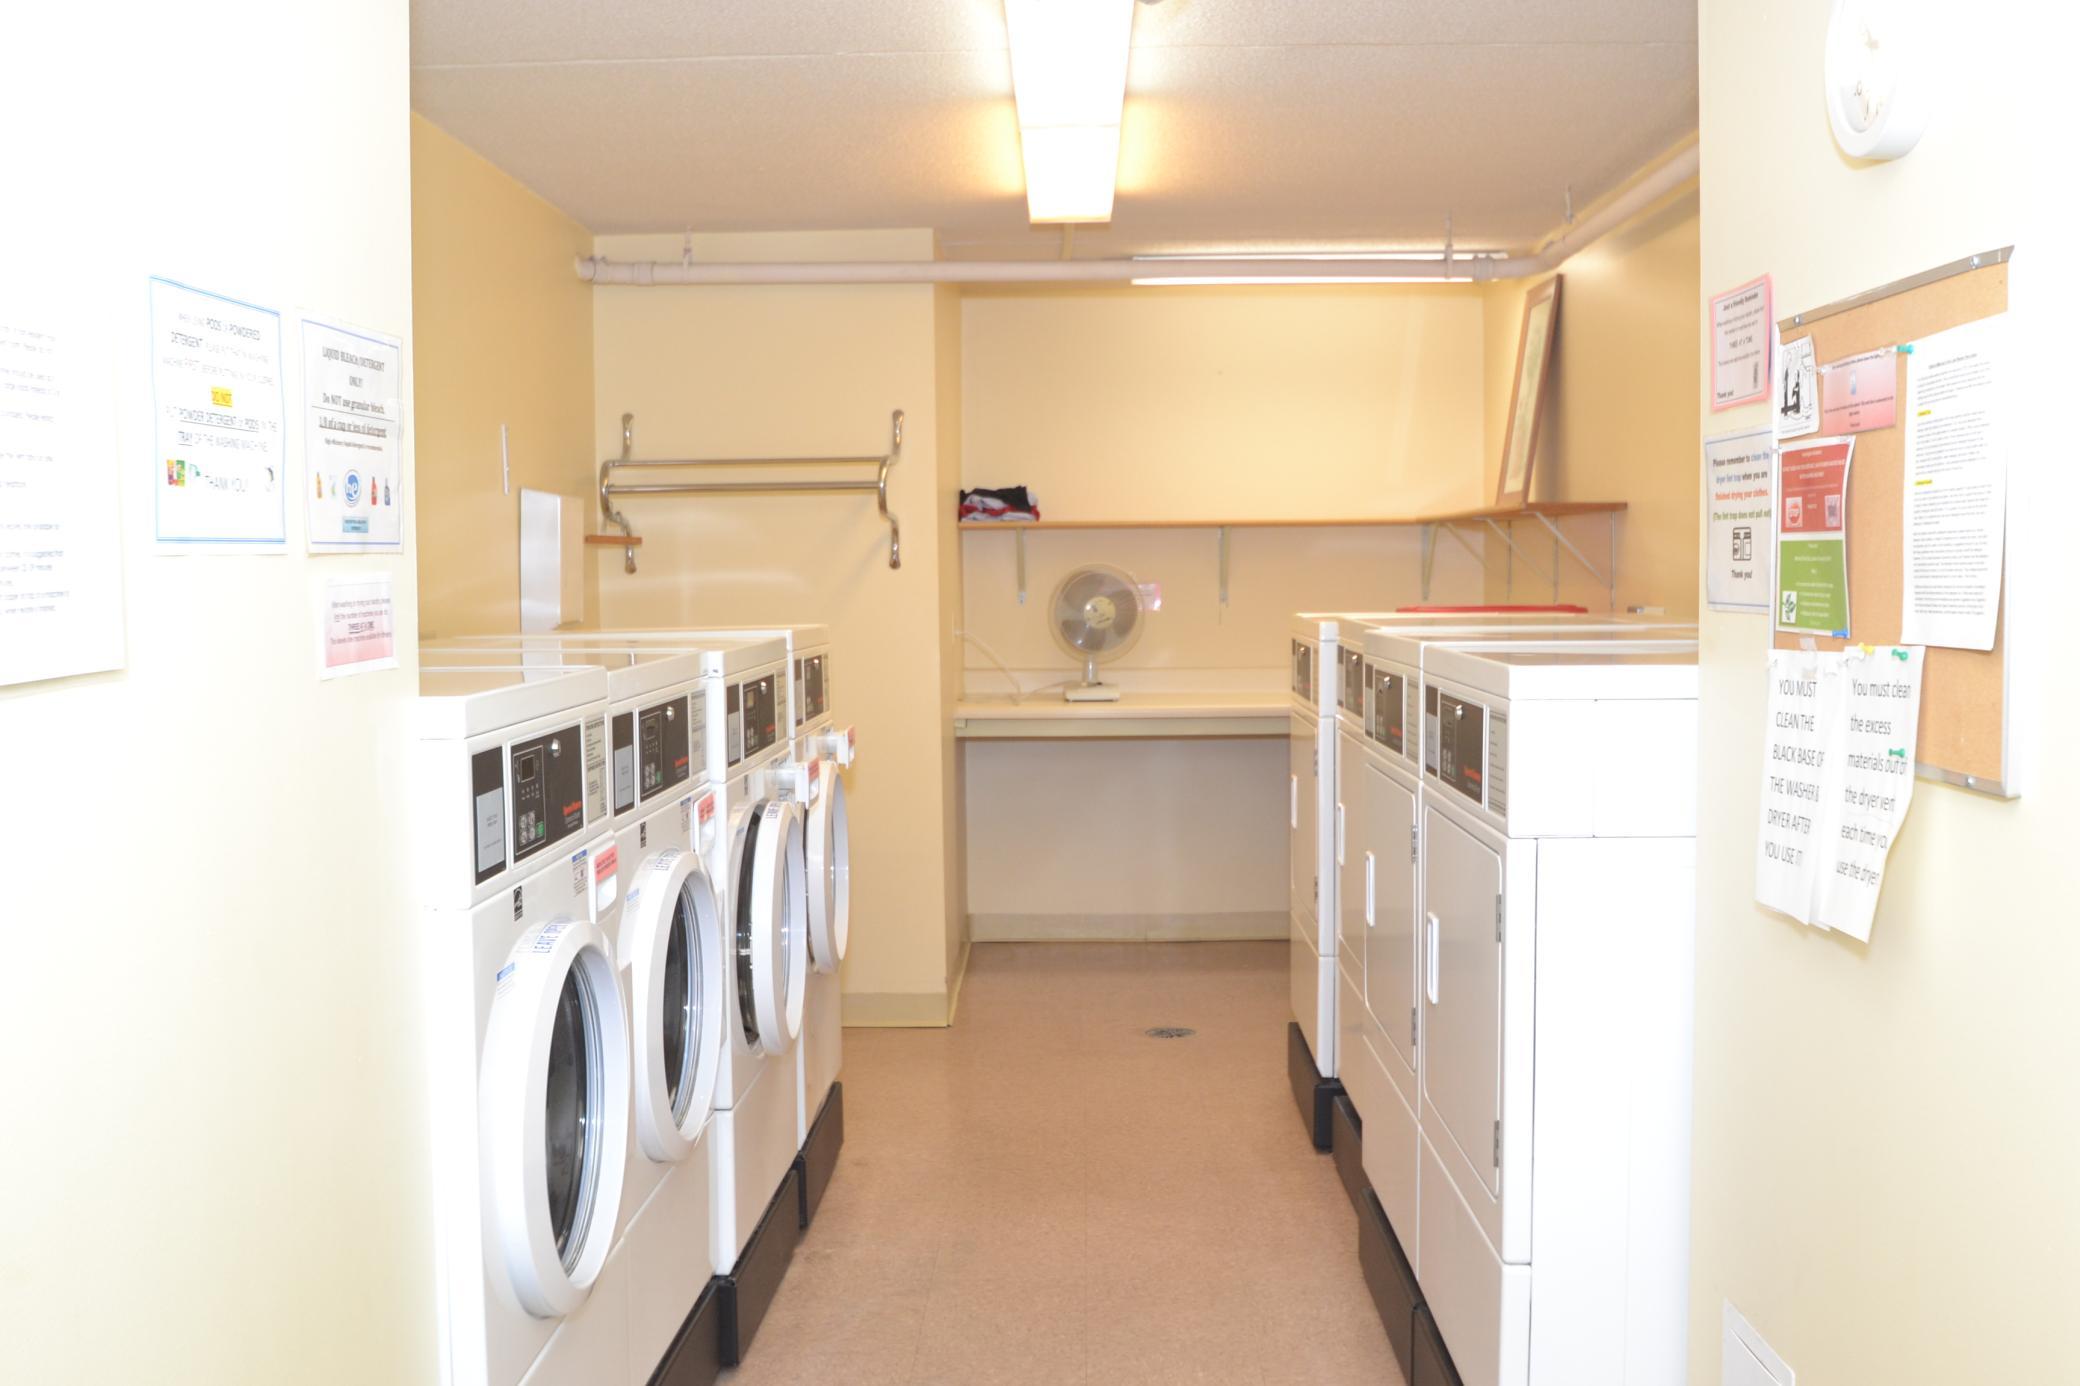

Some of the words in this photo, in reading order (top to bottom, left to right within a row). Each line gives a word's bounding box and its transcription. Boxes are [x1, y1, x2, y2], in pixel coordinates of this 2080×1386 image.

[323, 392, 330, 403] Do
[331, 394, 342, 406] NOT
[1726, 455, 1746, 466] remember
[1779, 679, 1794, 696] YOU
[1796, 680, 1817, 698] MUST
[1852, 679, 1868, 696] You
[1870, 681, 1890, 697] must
[1892, 680, 1911, 698] clean
[1776, 711, 1799, 729] CLEAN
[1800, 714, 1815, 732] THE
[1851, 713, 1863, 732] the
[1865, 719, 1892, 735] excess
[1773, 744, 1797, 762] BLACK
[1798, 747, 1816, 766] BASE
[1848, 752, 1884, 772] materials
[1885, 758, 1899, 774] out
[1770, 776, 1784, 794] THE
[1845, 784, 1857, 804] the
[1859, 788, 1880, 811] dryer
[1768, 808, 1790, 829] DRYER
[1792, 815, 1811, 834] AFTER
[1842, 823, 1858, 841] each
[1860, 826, 1875, 846] time
[1765, 839, 1780, 859] YOU
[1781, 846, 1795, 864] USE
[1836, 861, 1848, 876] use
[1849, 860, 1861, 880] the
